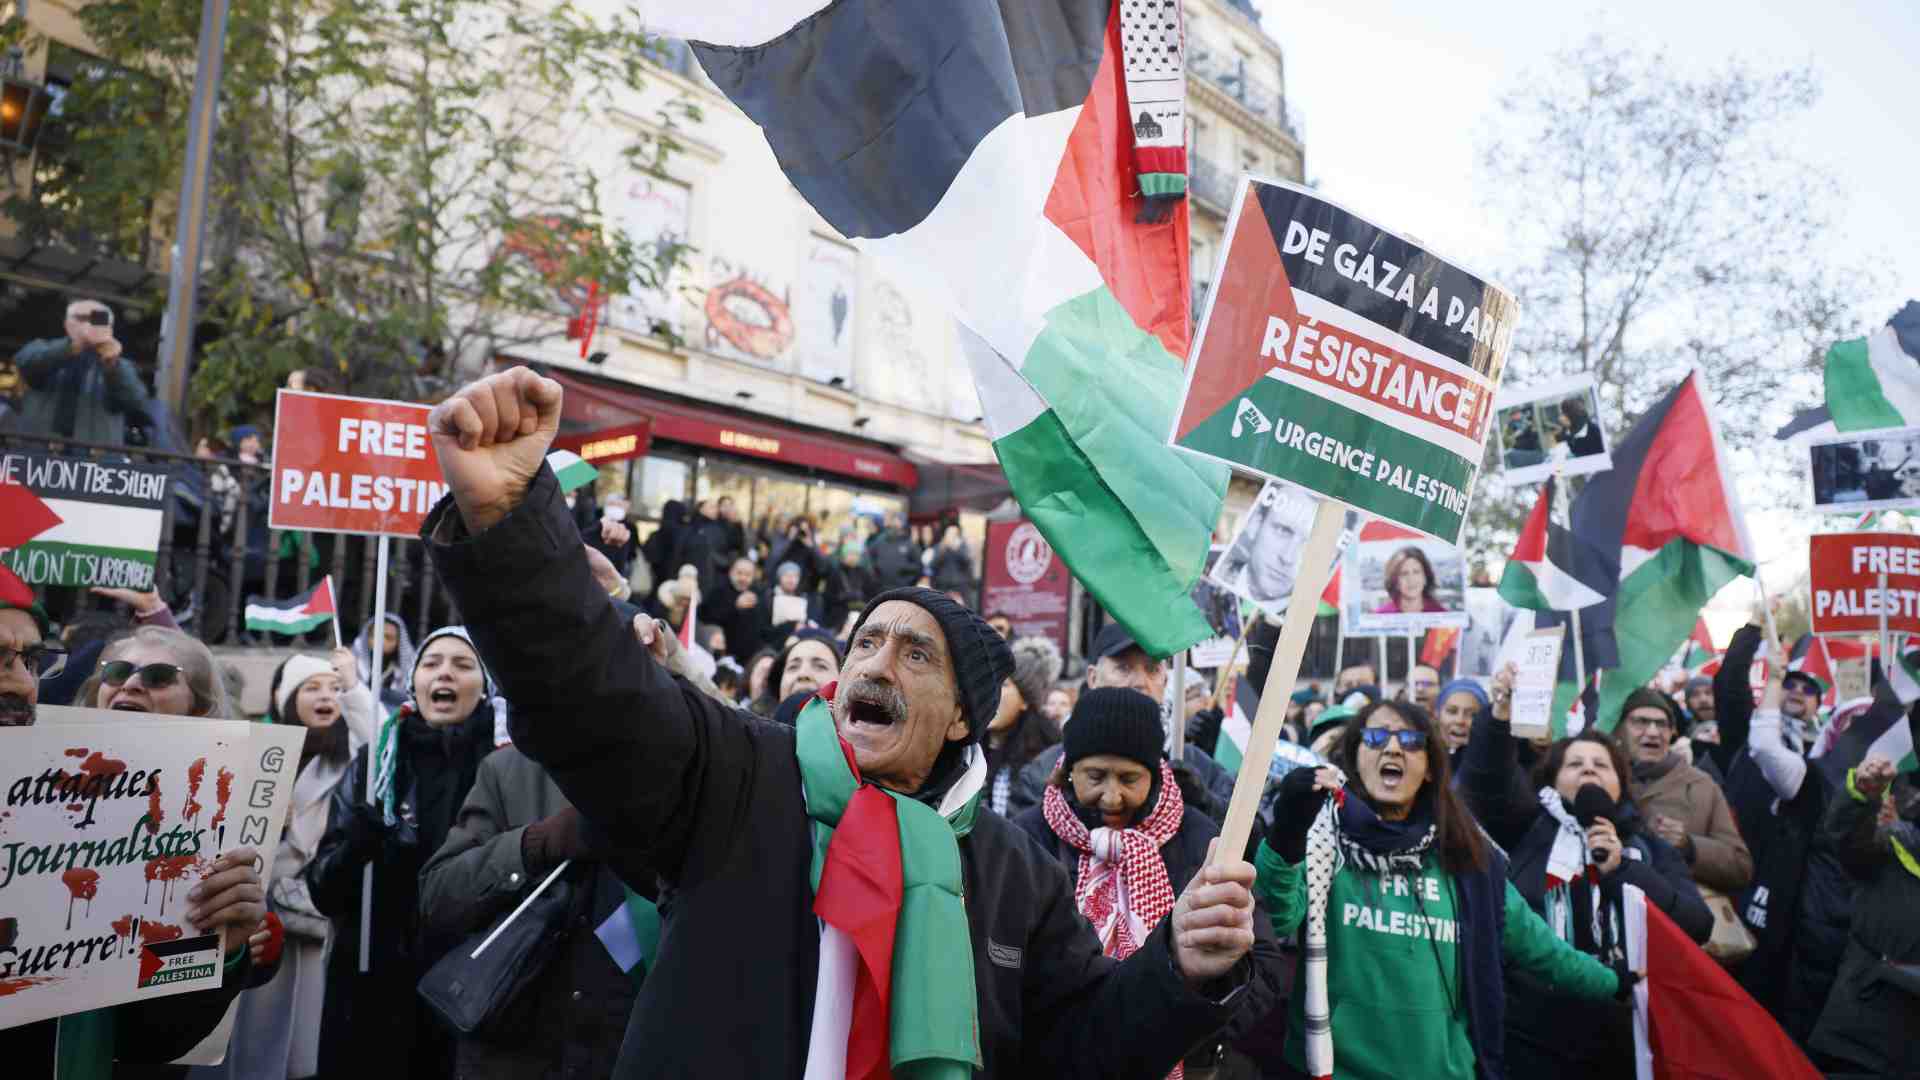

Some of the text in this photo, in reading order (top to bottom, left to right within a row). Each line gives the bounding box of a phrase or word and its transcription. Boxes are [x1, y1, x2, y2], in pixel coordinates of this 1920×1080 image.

[1282, 220, 1330, 265] DE
[1334, 243, 1417, 308] GAZA
[1419, 286, 1440, 321] A
[1260, 313, 1476, 430] RÉSISTANCE
[338, 417, 427, 461] FREE
[1273, 418, 1375, 478] URGENCE
[1376, 458, 1468, 518] PALESTINE
[280, 468, 451, 515] PALESTIN
[1852, 546, 1920, 575] FREE
[7, 767, 162, 830] attaques
[1343, 903, 1460, 944] PALESTIN
[151, 967, 212, 985] PALESTINA
[168, 955, 195, 967] FREE
